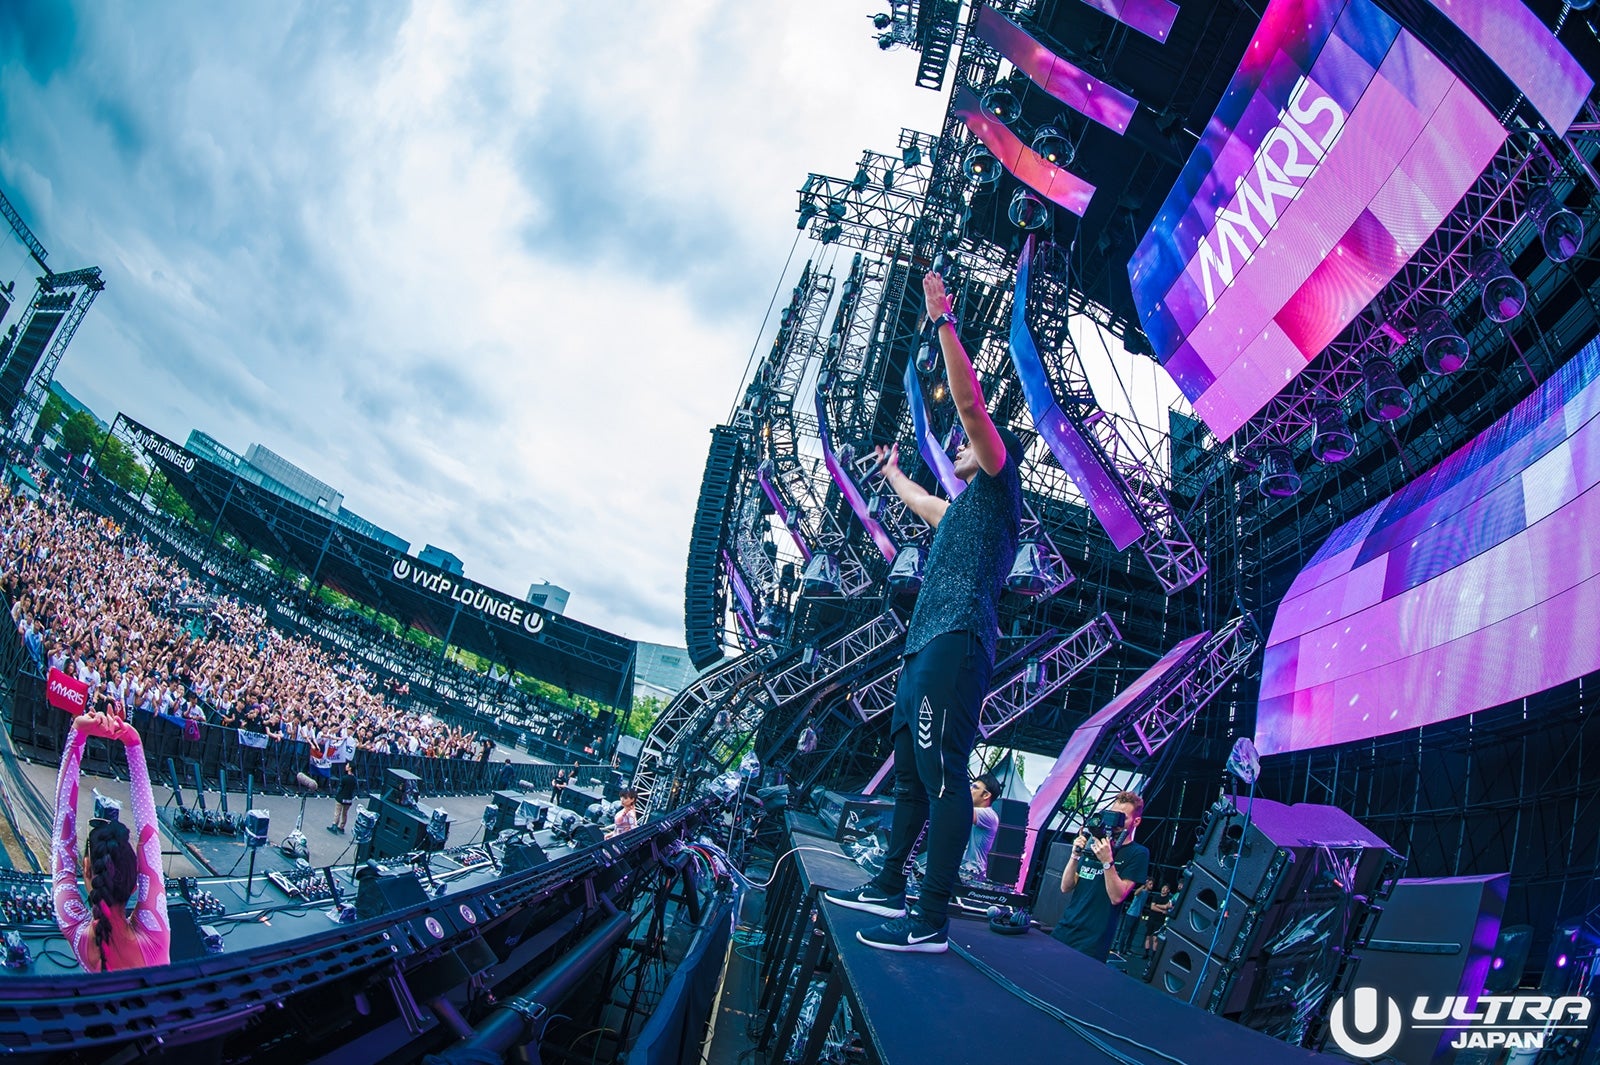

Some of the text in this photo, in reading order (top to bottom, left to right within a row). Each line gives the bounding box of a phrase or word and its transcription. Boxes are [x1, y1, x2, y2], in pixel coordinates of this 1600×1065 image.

[1198, 75, 1345, 315] MYKRIS
[155, 441, 187, 468] LOUNGE
[412, 567, 451, 594] VVIP
[451, 584, 524, 625] LOUNGE
[968, 890, 998, 901] Pioneer
